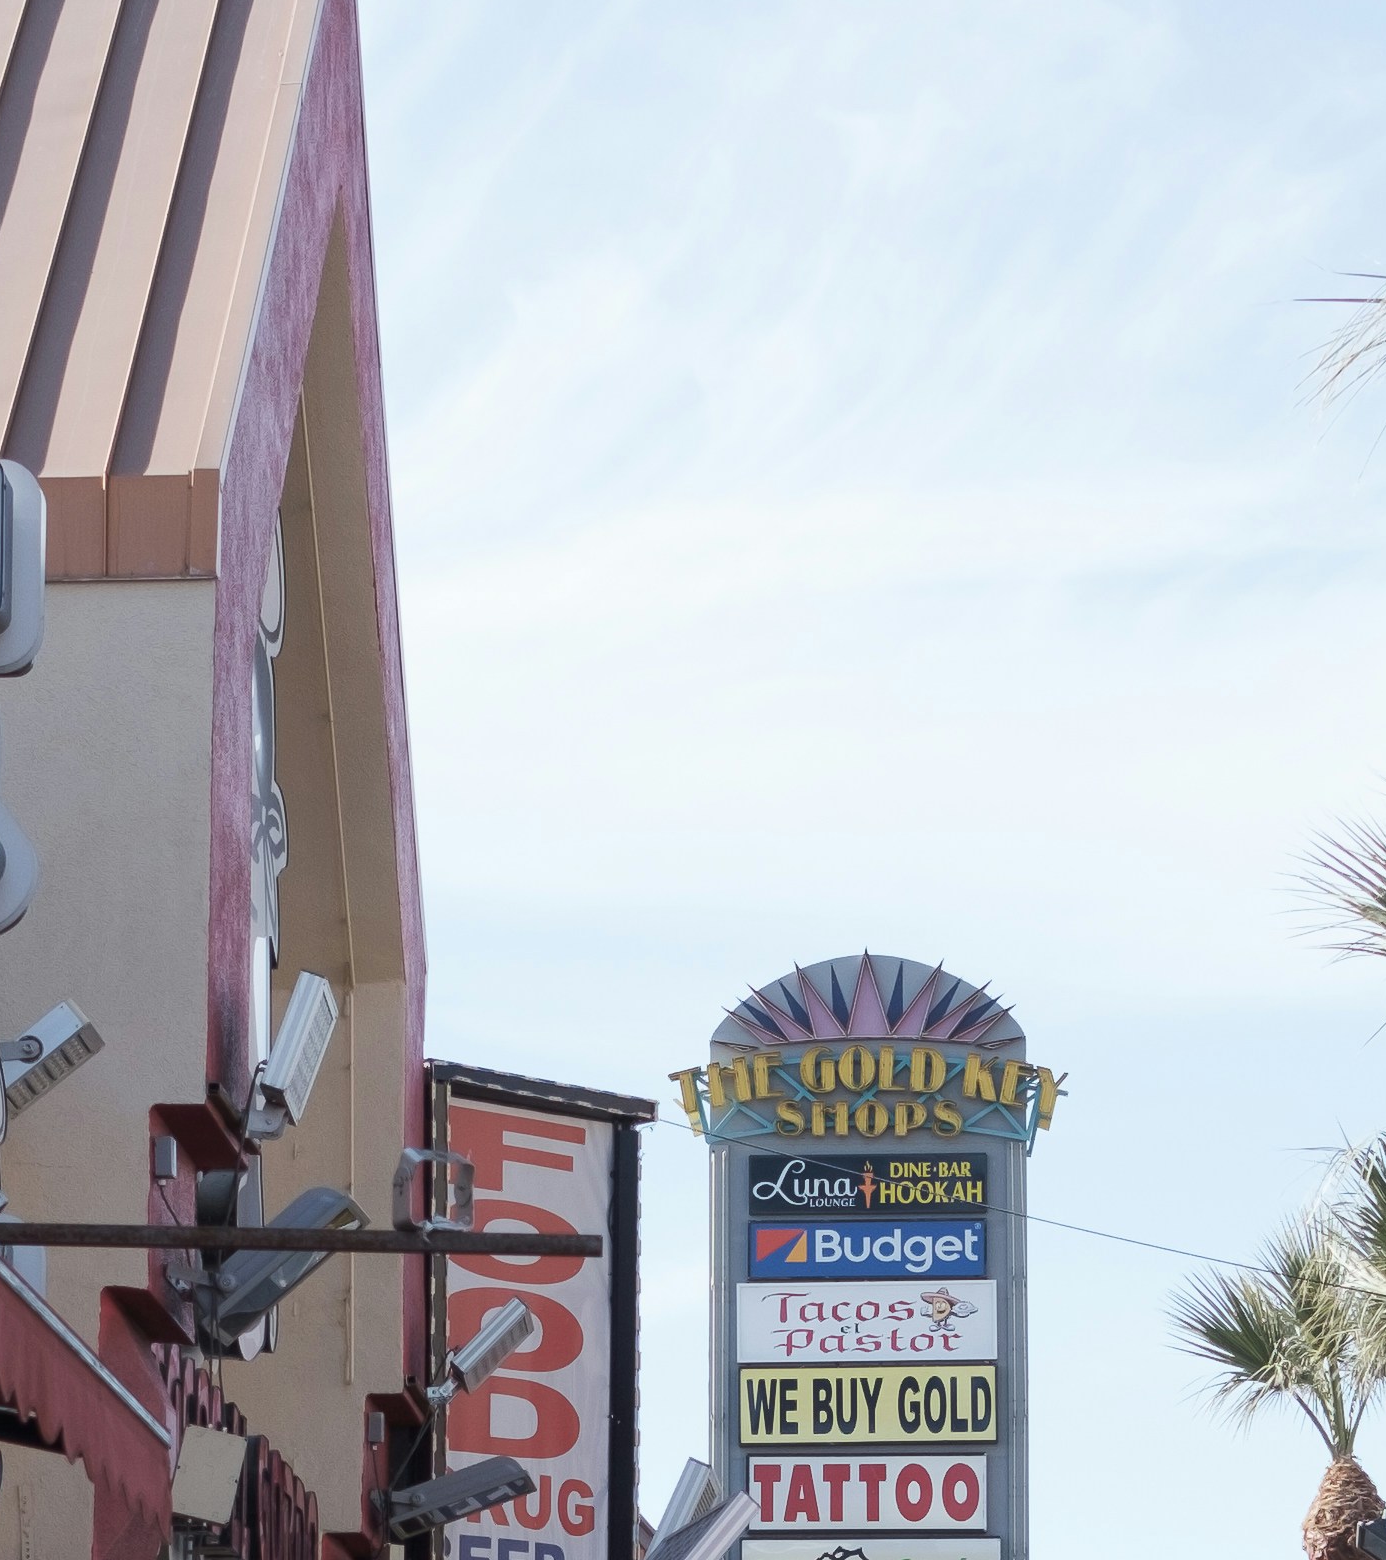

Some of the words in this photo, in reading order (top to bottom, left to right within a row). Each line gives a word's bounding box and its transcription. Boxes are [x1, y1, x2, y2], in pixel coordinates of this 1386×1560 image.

[668, 1051, 785, 1130] THE
[800, 1044, 947, 1095] GOLD
[962, 1051, 1068, 1128] KEY
[775, 1097, 964, 1138] SHOPS
[752, 1159, 858, 1206] Luna
[809, 1197, 856, 1207] LOUNGE
[879, 1180, 983, 1204] HOOKAH
[815, 1228, 979, 1273] Budget
[447, 1104, 587, 1460] FOOD
[761, 1292, 916, 1323] Tacos
[840, 1322, 861, 1334] el
[771, 1327, 964, 1357] Pastor
[746, 1378, 799, 1435] WE
[812, 1377, 884, 1435] BUY
[897, 1375, 992, 1434] GOLD
[447, 1467, 595, 1537] UG
[753, 1462, 980, 1523] TATTOO
